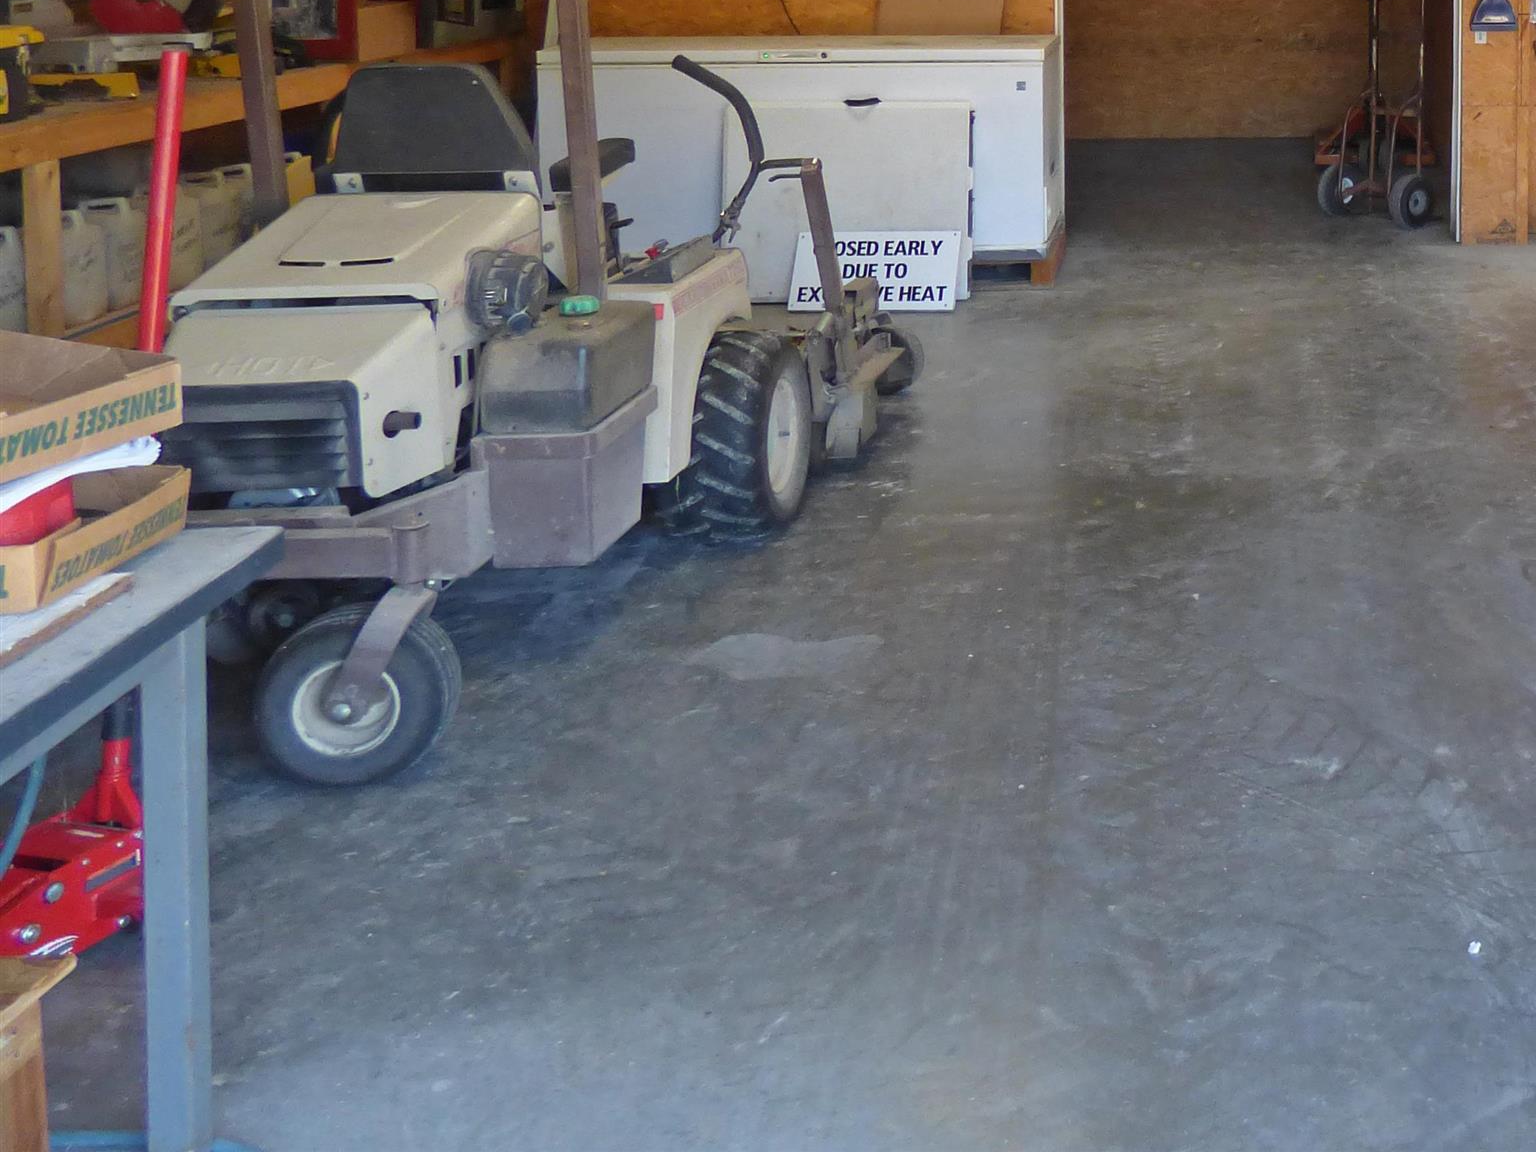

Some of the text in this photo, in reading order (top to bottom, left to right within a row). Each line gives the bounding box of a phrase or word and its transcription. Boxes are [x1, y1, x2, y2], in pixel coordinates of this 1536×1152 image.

[835, 240, 943, 257] OSED EARLY
[842, 263, 908, 279] DUE TO
[899, 286, 947, 302] HEAT
[73, 382, 176, 440] TENNESSEE
